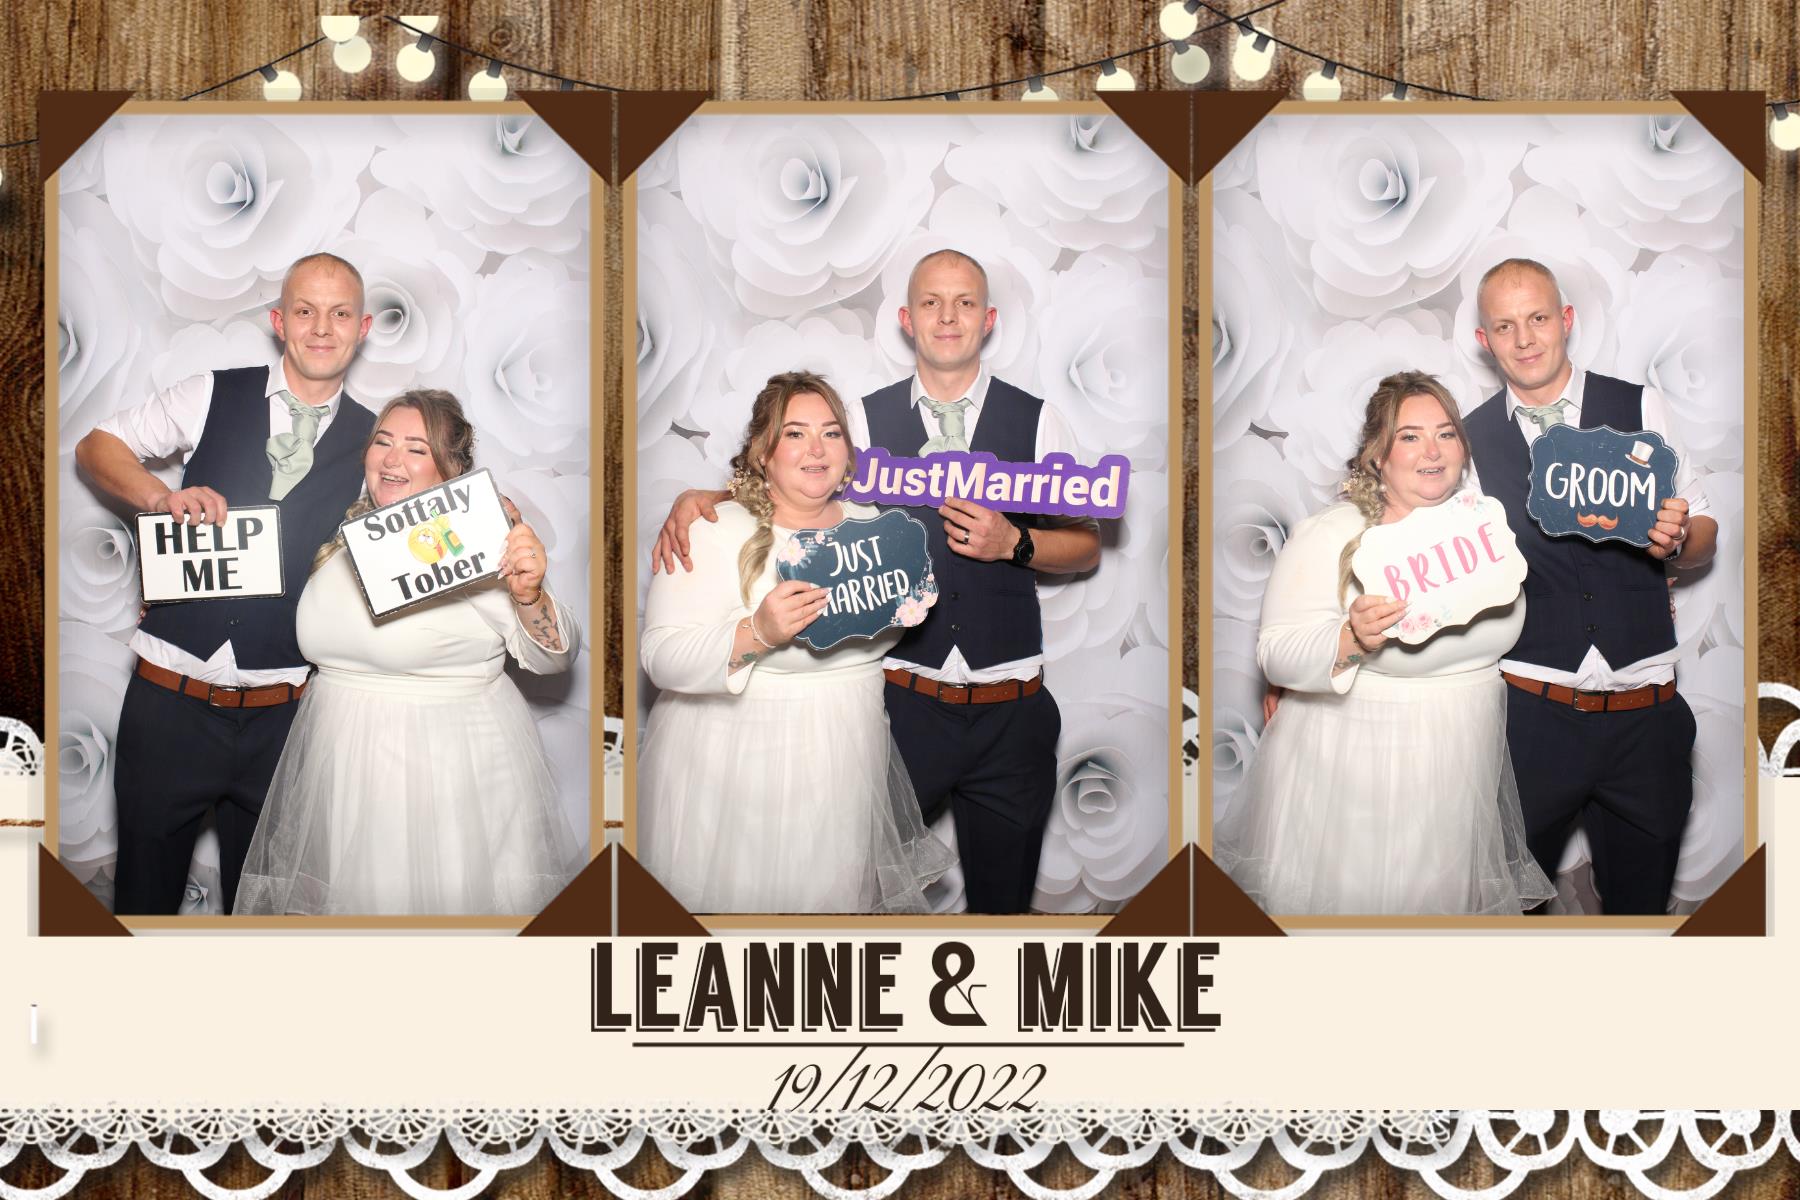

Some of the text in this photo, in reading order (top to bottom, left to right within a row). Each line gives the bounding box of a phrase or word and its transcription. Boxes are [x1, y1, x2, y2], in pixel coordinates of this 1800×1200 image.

[1545, 462, 1656, 510] GROOM
[155, 517, 263, 555] HELP
[363, 483, 471, 541] Sottaly
[182, 557, 242, 592] ME
[391, 551, 486, 601] Tober
[826, 535, 883, 577] JUST
[1383, 522, 1505, 602] BRIDE
